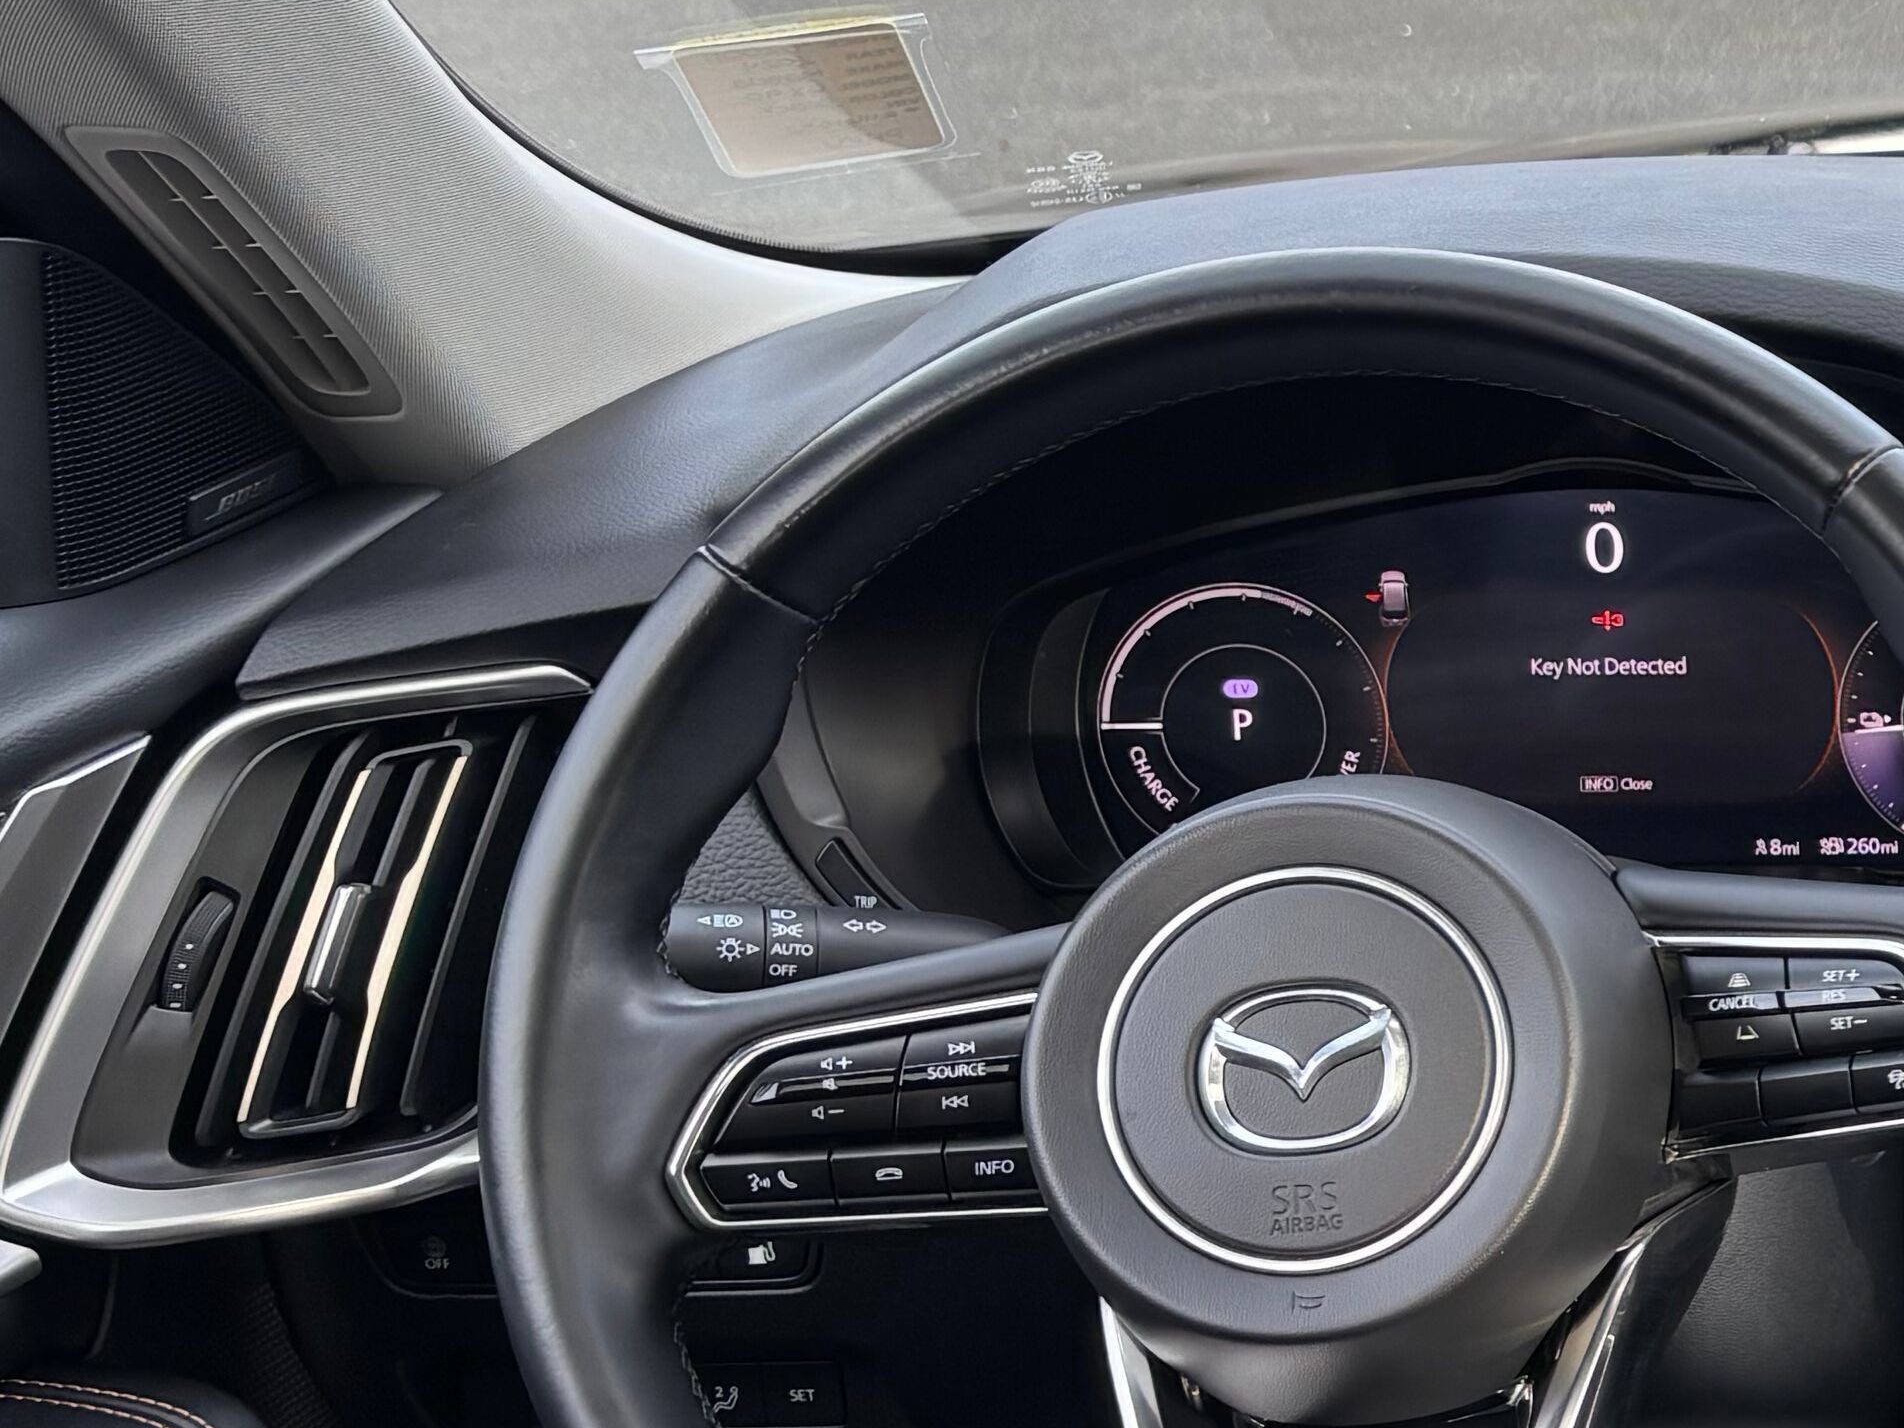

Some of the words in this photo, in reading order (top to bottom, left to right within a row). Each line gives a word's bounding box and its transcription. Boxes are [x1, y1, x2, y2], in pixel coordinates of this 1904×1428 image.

[1589, 501, 1616, 517] mph
[1584, 521, 1625, 574] 0
[1530, 657, 1563, 679] Key
[1567, 657, 1597, 675] Not
[1602, 655, 1687, 675] Detected
[1233, 709, 1253, 740] P
[1129, 745, 1179, 812] CHARGE
[1585, 778, 1615, 792] INFO
[1620, 778, 1653, 792] Close
[1847, 838, 1899, 856] 260mi
[854, 896, 878, 909] TRIP
[770, 942, 814, 957] AUTO
[769, 963, 798, 977] OFF
[1708, 994, 1759, 1012] CANCEL
[1821, 988, 1847, 1003] RES
[927, 1063, 987, 1080] SOURCE
[974, 1159, 1015, 1176] INFO
[1271, 1181, 1339, 1215] SRS
[1269, 1214, 1344, 1236] AIRBAG
[424, 1257, 450, 1270] OFF
[789, 1389, 815, 1403] SET
